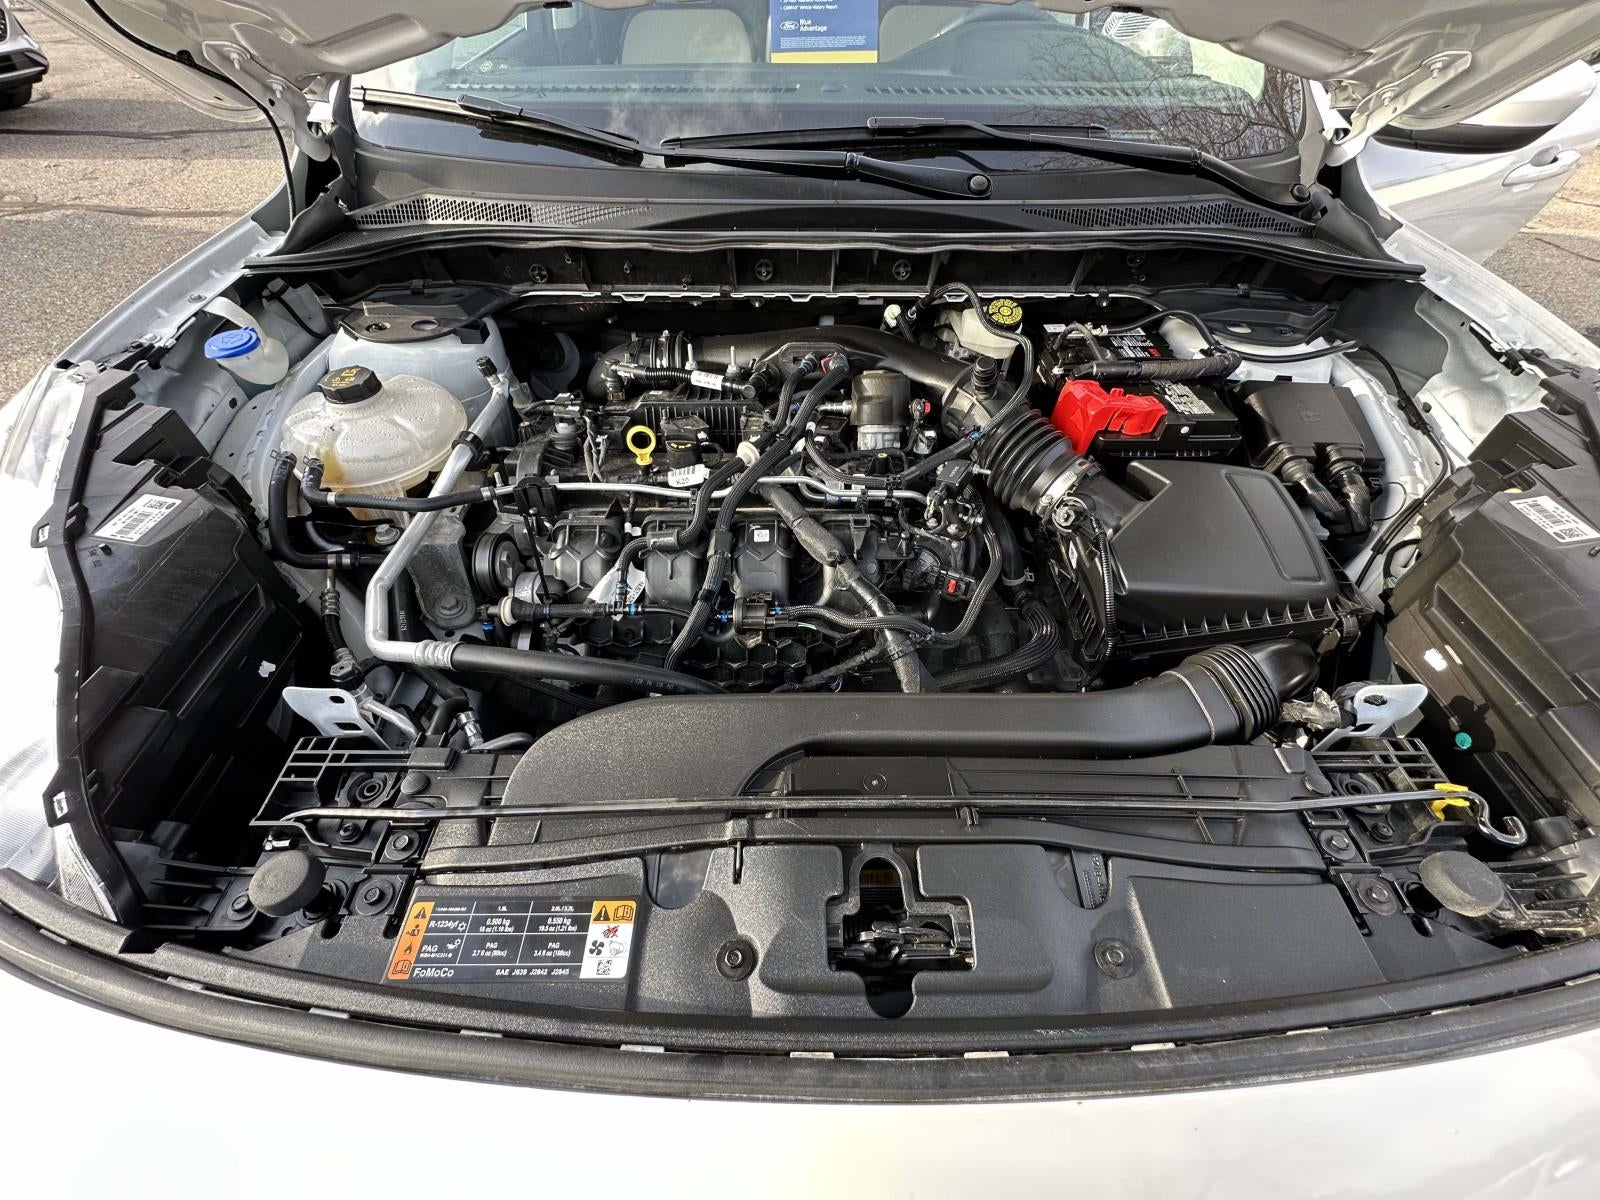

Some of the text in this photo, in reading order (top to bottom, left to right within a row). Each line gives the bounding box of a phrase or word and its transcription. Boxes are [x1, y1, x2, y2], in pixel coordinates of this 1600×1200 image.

[429, 920, 459, 929] R-1234yf
[502, 918, 510, 926] kg
[564, 916, 571, 926] kg
[422, 944, 438, 952] PAG
[413, 968, 454, 977] FoMoCo
